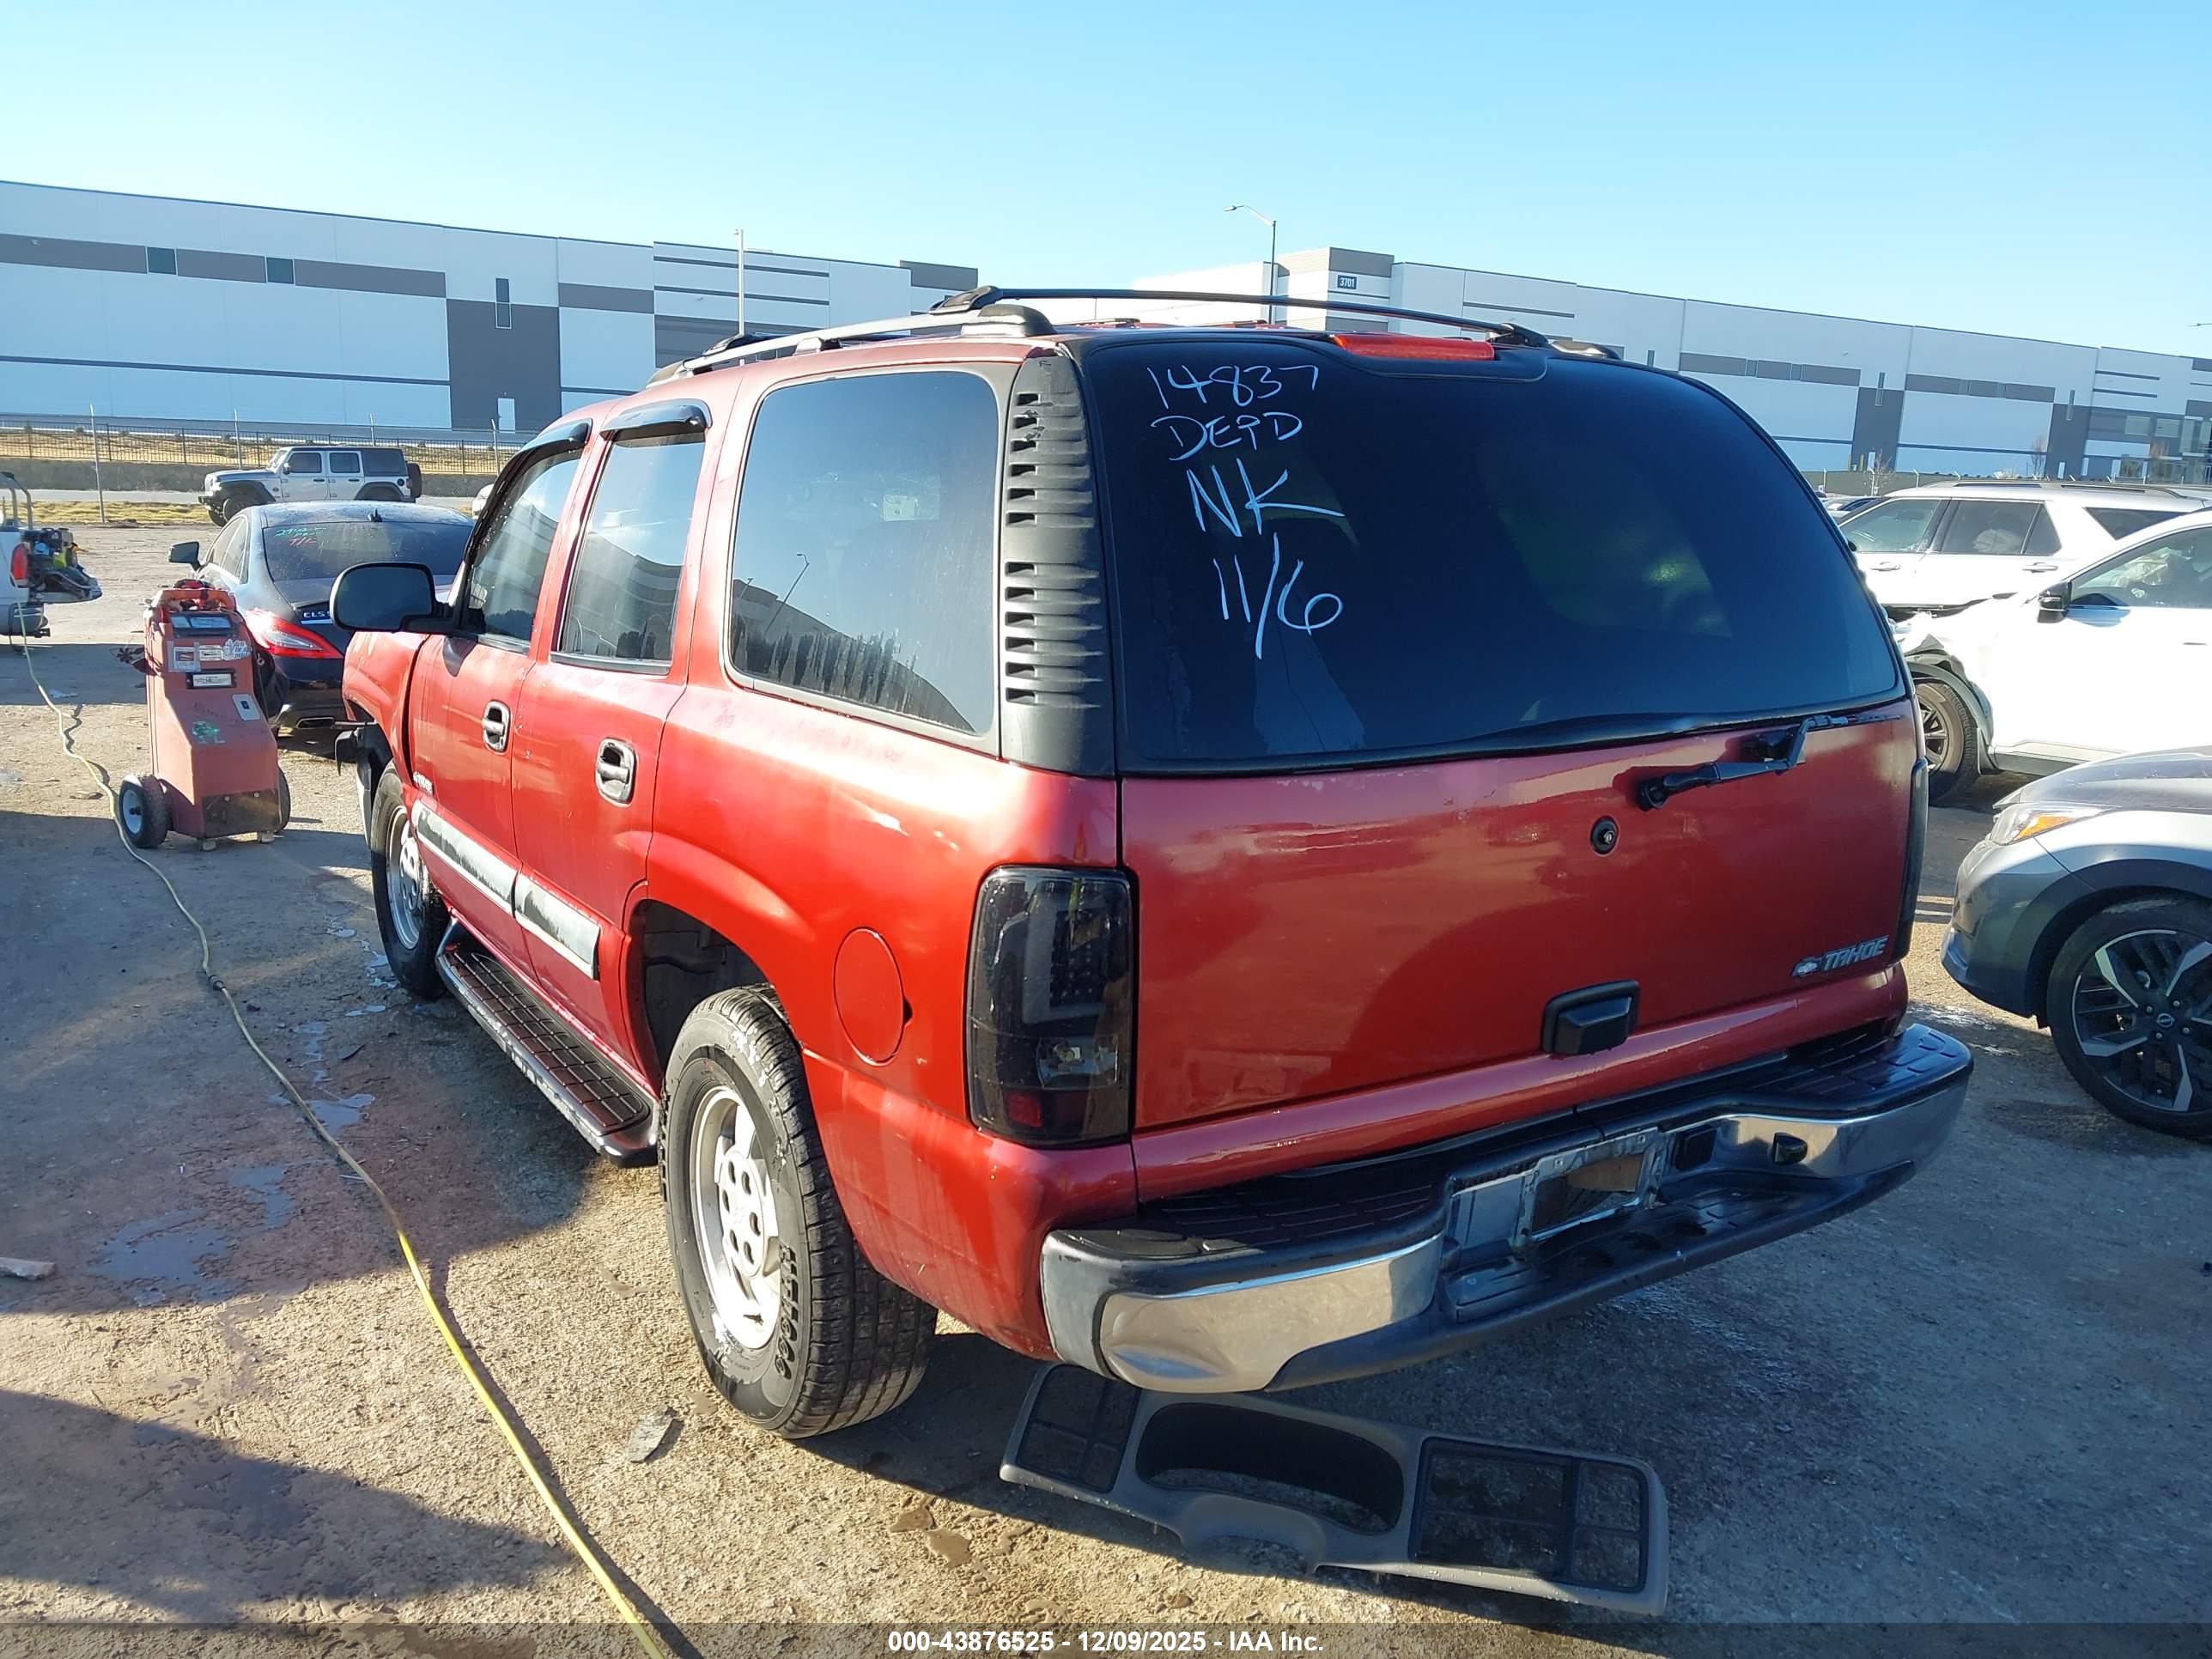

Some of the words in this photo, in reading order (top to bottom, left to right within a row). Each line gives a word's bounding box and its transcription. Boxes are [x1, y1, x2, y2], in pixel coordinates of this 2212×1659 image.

[1340, 276, 1355, 288] 3701
[1147, 364, 1319, 410] 14837
[1186, 457, 1346, 538] NK
[1212, 532, 1344, 660] 11/6
[1823, 934, 1890, 971] TAHOE
